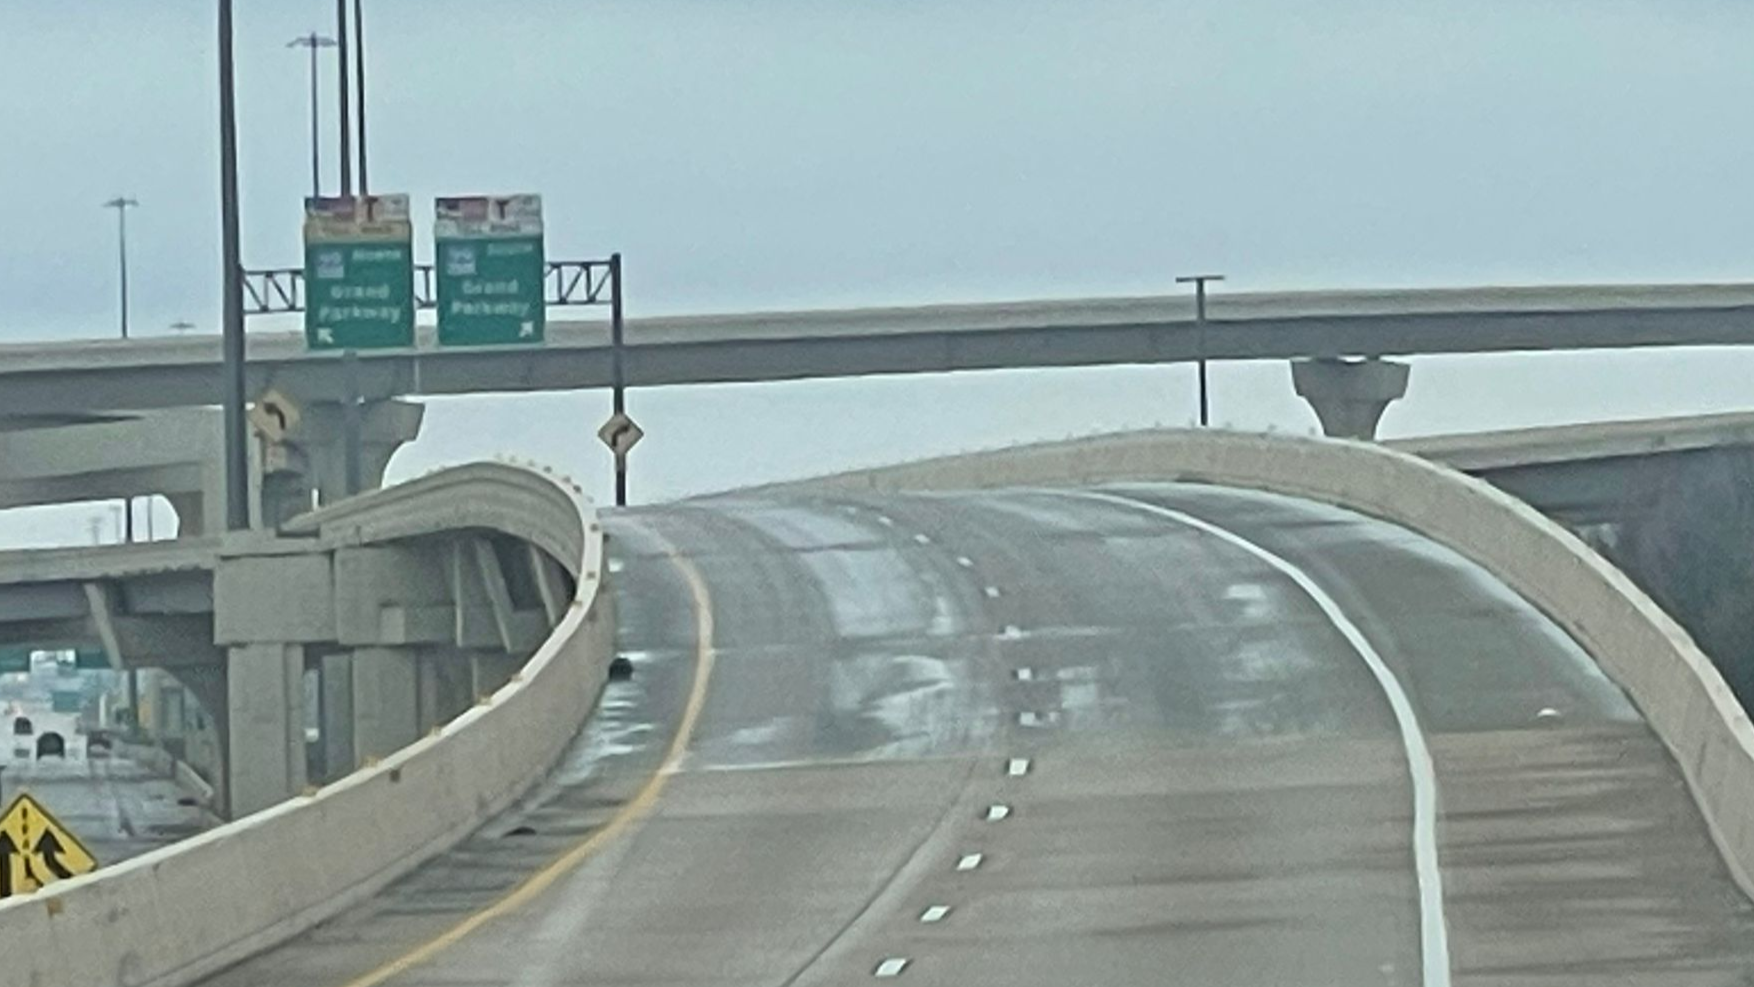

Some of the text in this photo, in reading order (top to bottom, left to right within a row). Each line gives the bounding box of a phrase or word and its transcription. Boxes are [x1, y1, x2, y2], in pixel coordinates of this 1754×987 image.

[462, 279, 519, 295] Grand
[318, 306, 400, 323] Parkway
[452, 301, 530, 318] Parkway
